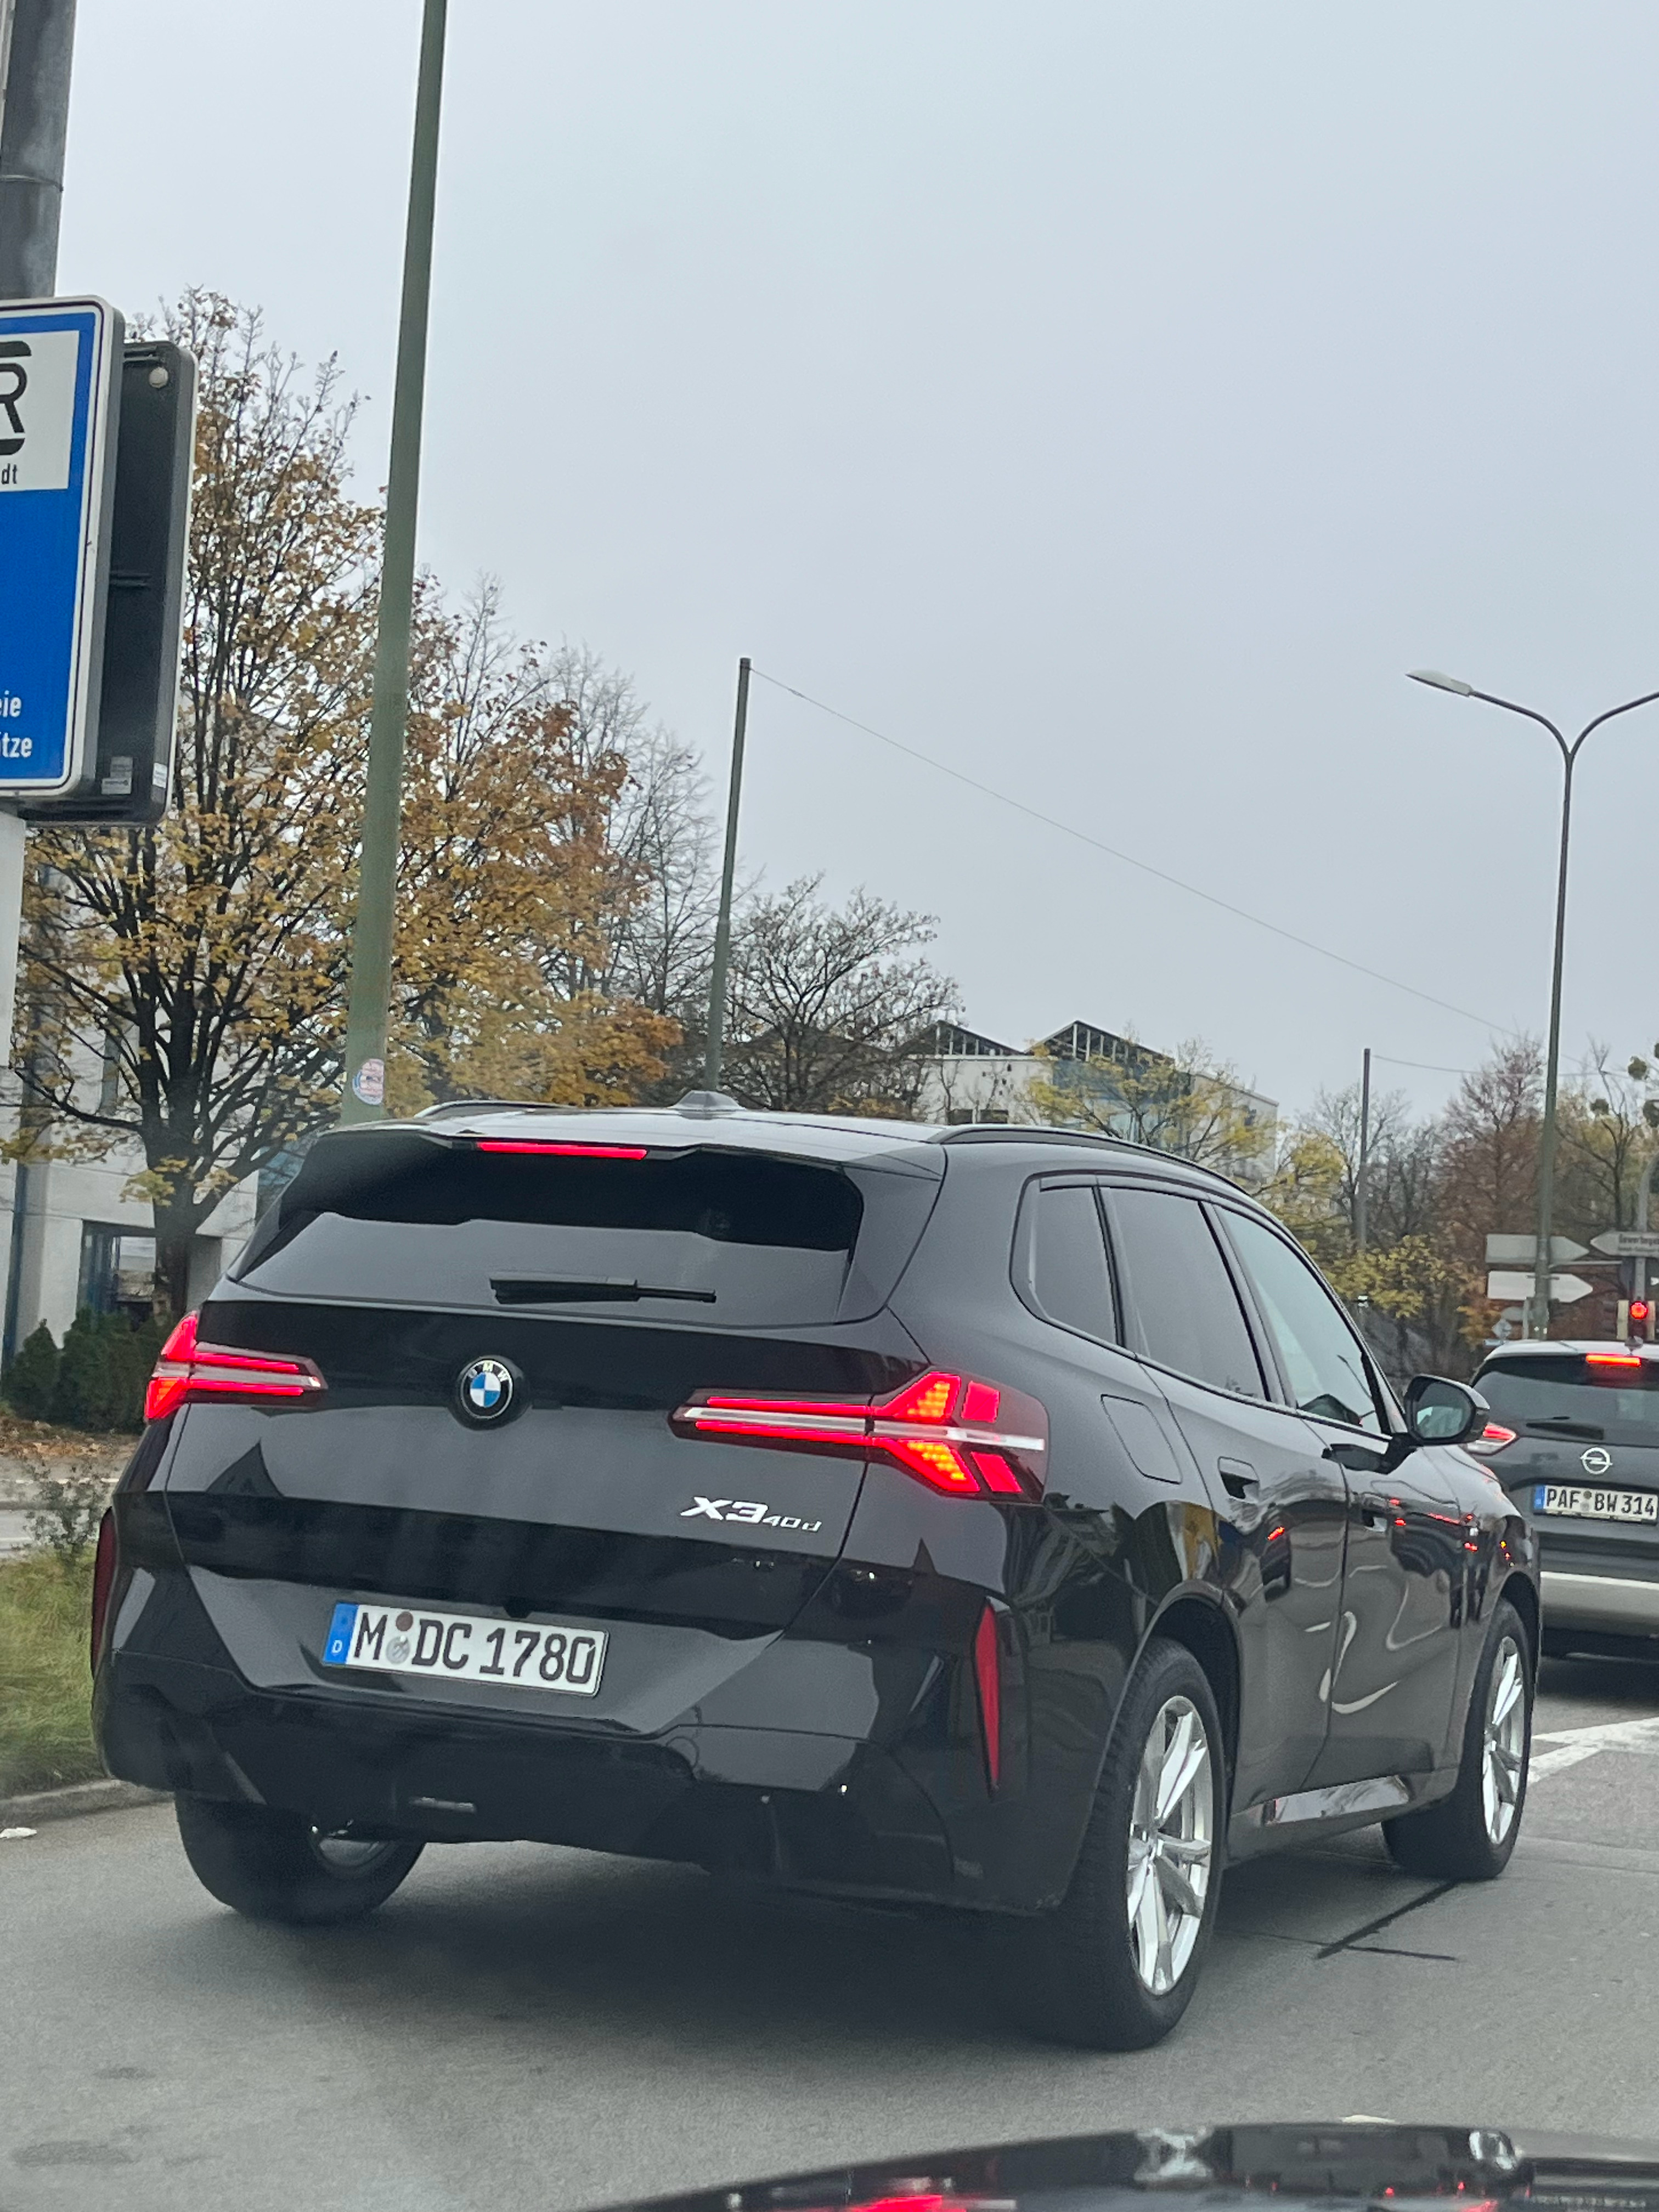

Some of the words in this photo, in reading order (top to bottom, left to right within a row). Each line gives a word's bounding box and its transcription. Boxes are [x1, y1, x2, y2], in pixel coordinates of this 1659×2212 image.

[0, 690, 21, 718] ie
[0, 732, 33, 758] tze
[1547, 1489, 1581, 1509] PAF
[1622, 1494, 1654, 1516] 314
[354, 1612, 388, 1661] M
[411, 1618, 472, 1670] DC
[479, 1627, 595, 1684] 1780
